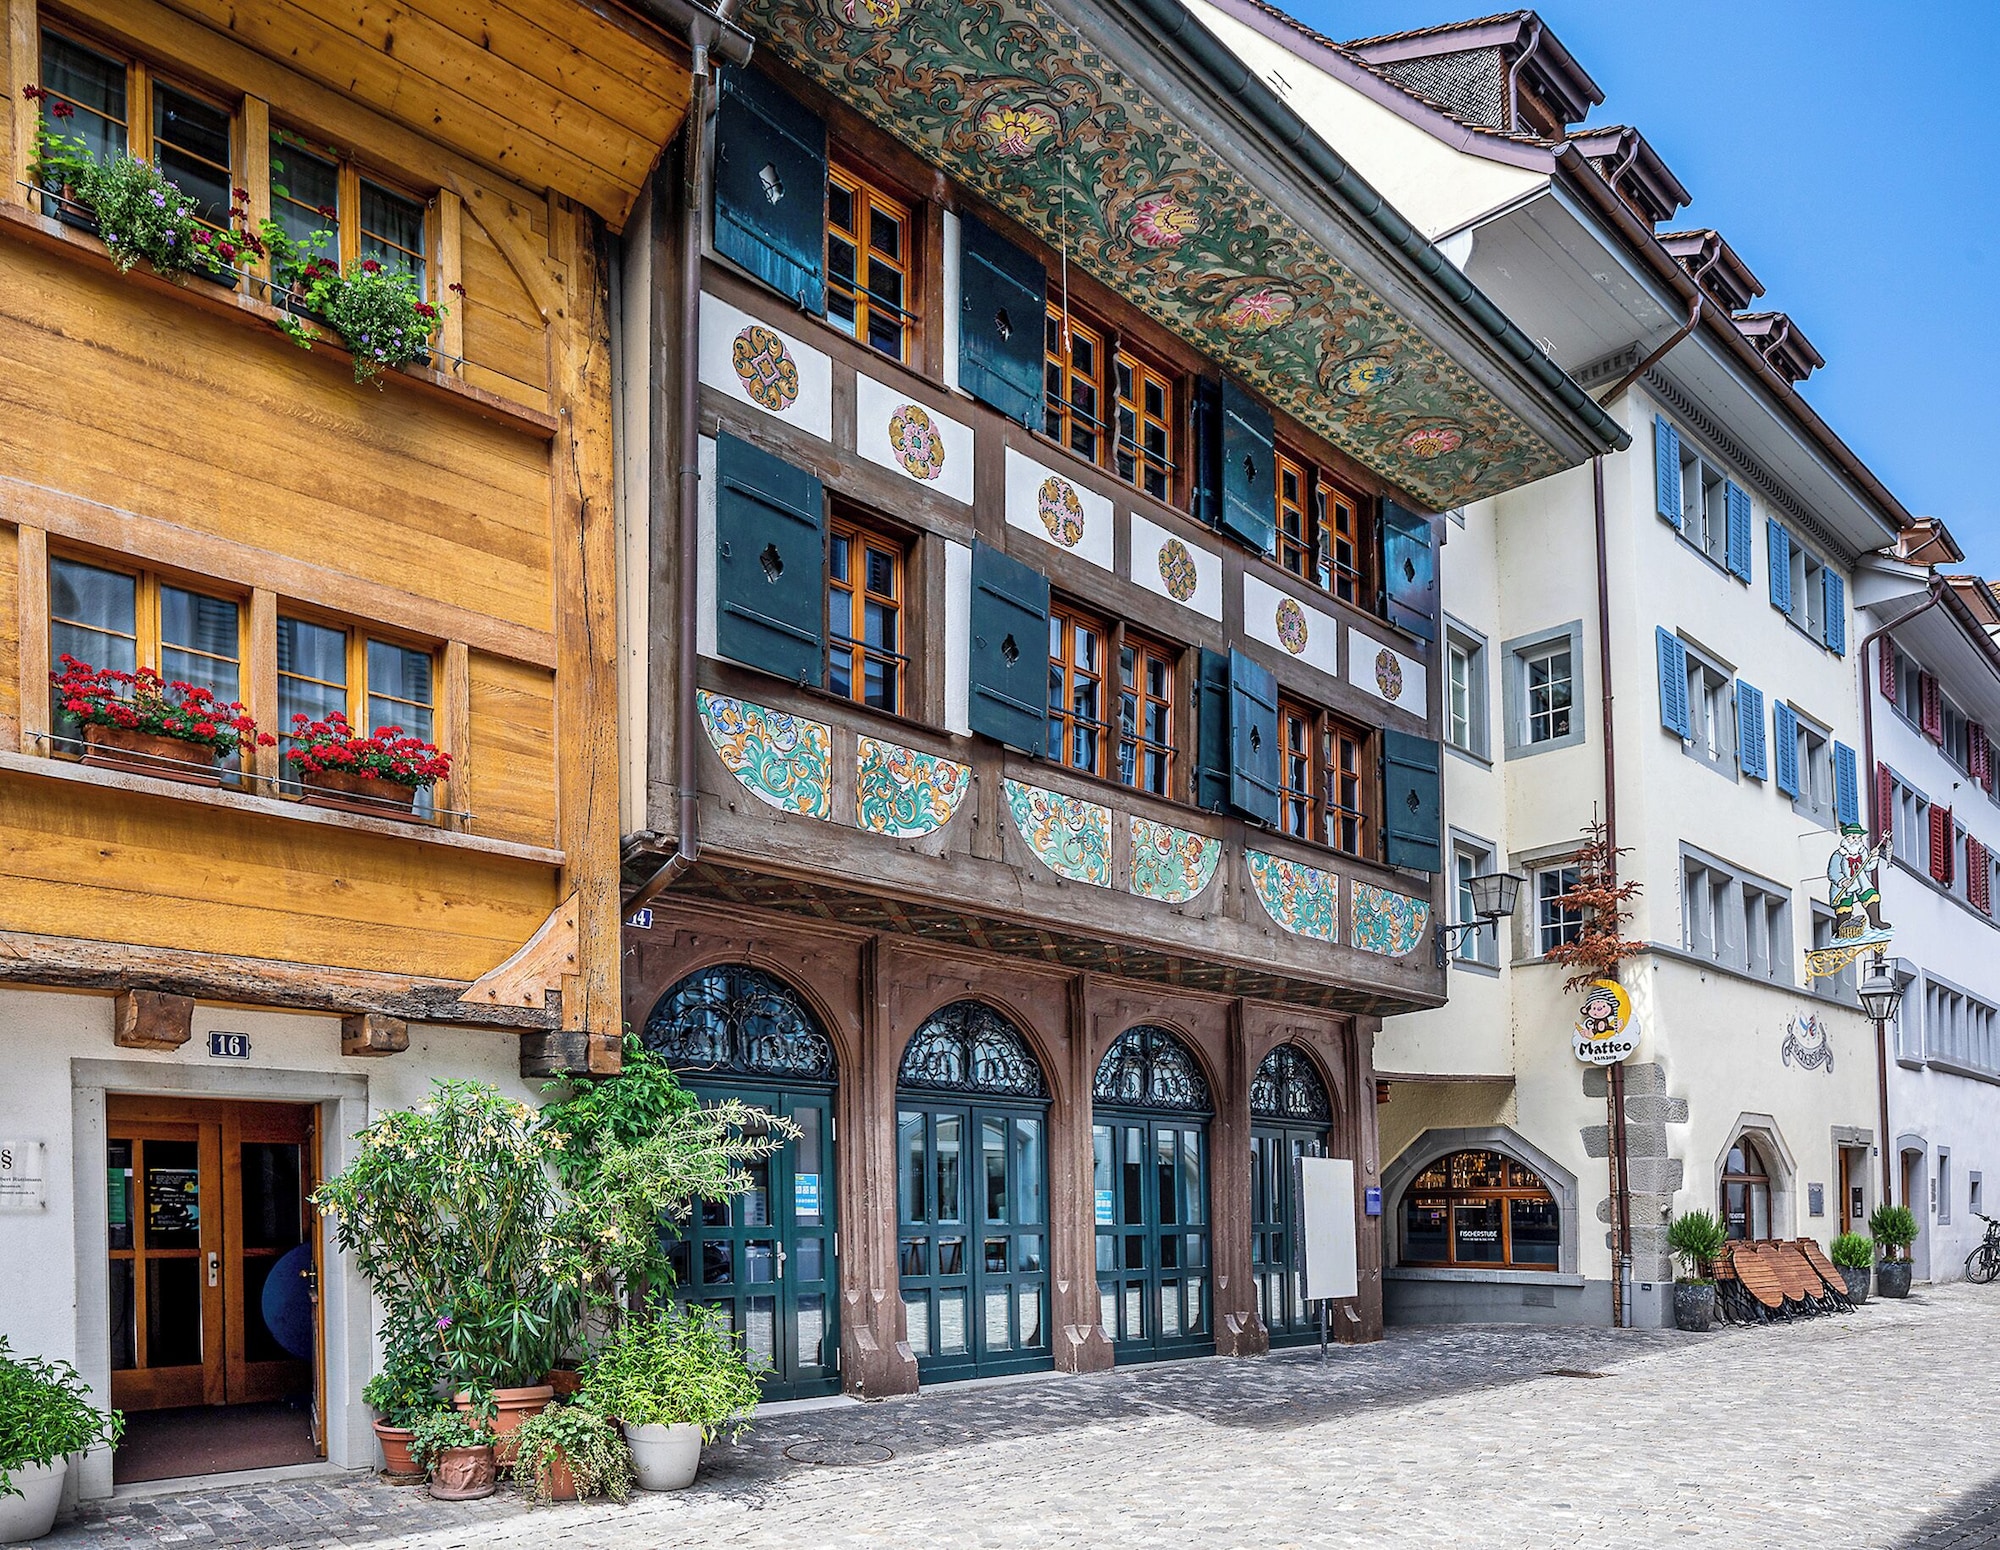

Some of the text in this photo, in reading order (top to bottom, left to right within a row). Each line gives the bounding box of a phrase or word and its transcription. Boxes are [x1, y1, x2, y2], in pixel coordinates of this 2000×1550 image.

[631, 910, 647, 926] 14
[218, 1035, 241, 1056] 16
[1579, 1041, 1632, 1056] Matteo
